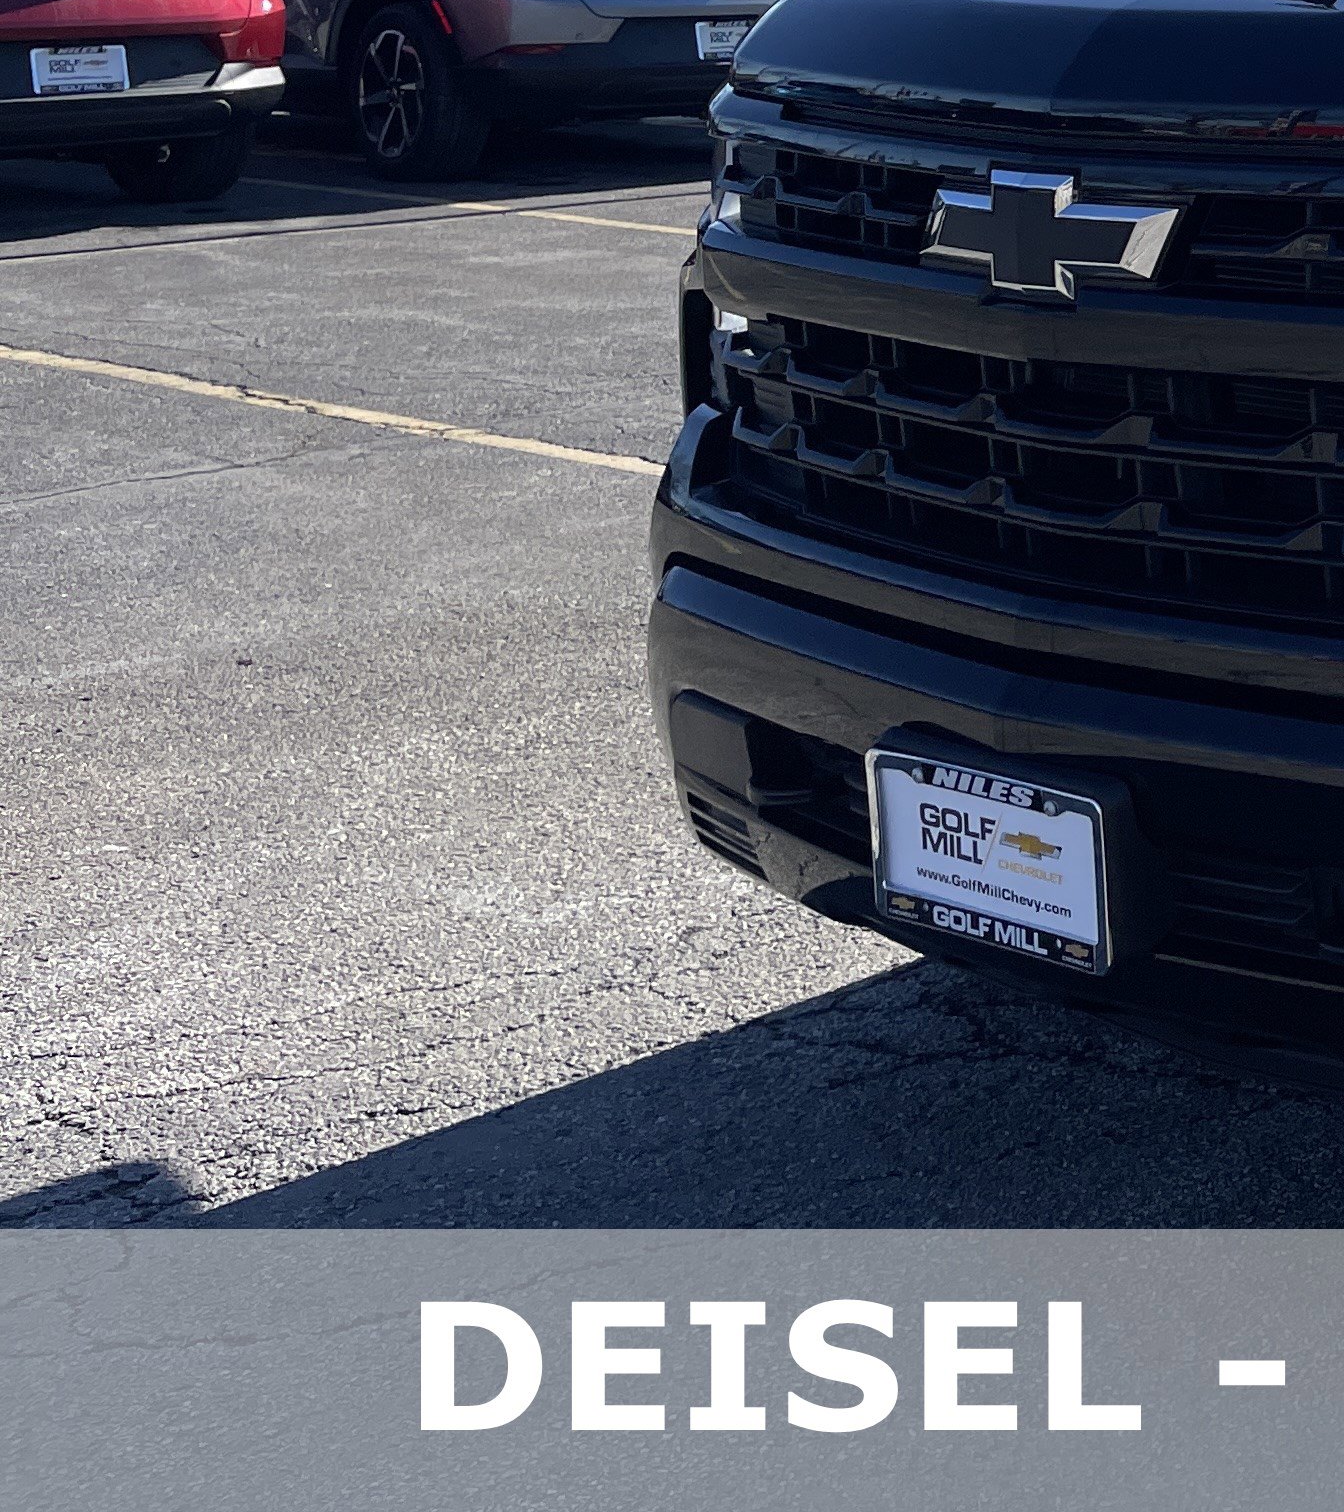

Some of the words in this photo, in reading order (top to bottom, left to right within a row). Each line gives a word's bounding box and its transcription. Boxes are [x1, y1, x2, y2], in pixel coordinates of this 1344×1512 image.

[931, 767, 1034, 807] NILES
[919, 803, 996, 841] GOLF
[921, 827, 984, 865] MILL
[916, 866, 1072, 918] www.GolfMillChevy.com
[932, 905, 992, 937] GOLF
[994, 921, 1049, 956] MILL
